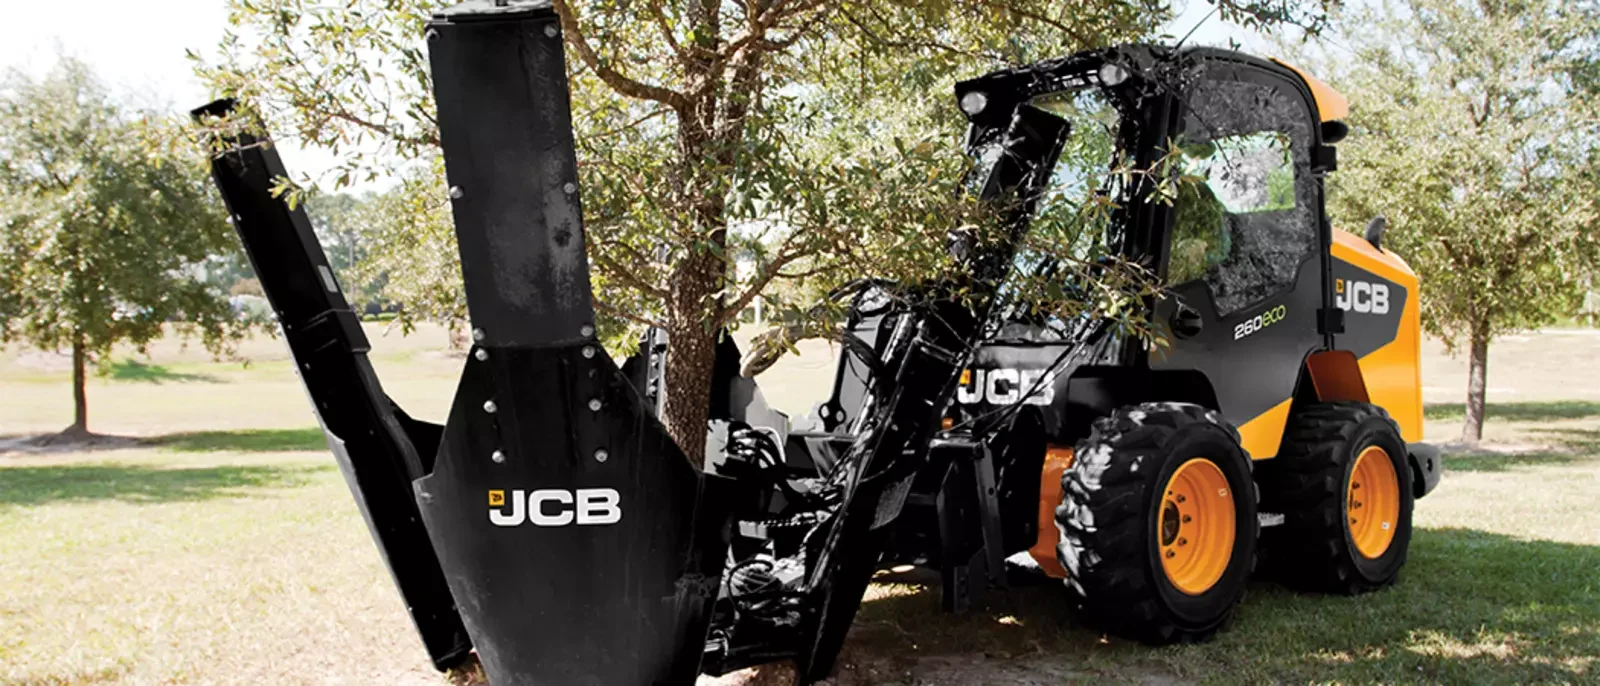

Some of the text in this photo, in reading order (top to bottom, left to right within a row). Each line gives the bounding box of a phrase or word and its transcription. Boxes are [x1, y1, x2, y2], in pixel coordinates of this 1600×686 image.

[1336, 280, 1389, 314] JCB
[958, 368, 1055, 406] JCB
[489, 488, 621, 526] JCB
